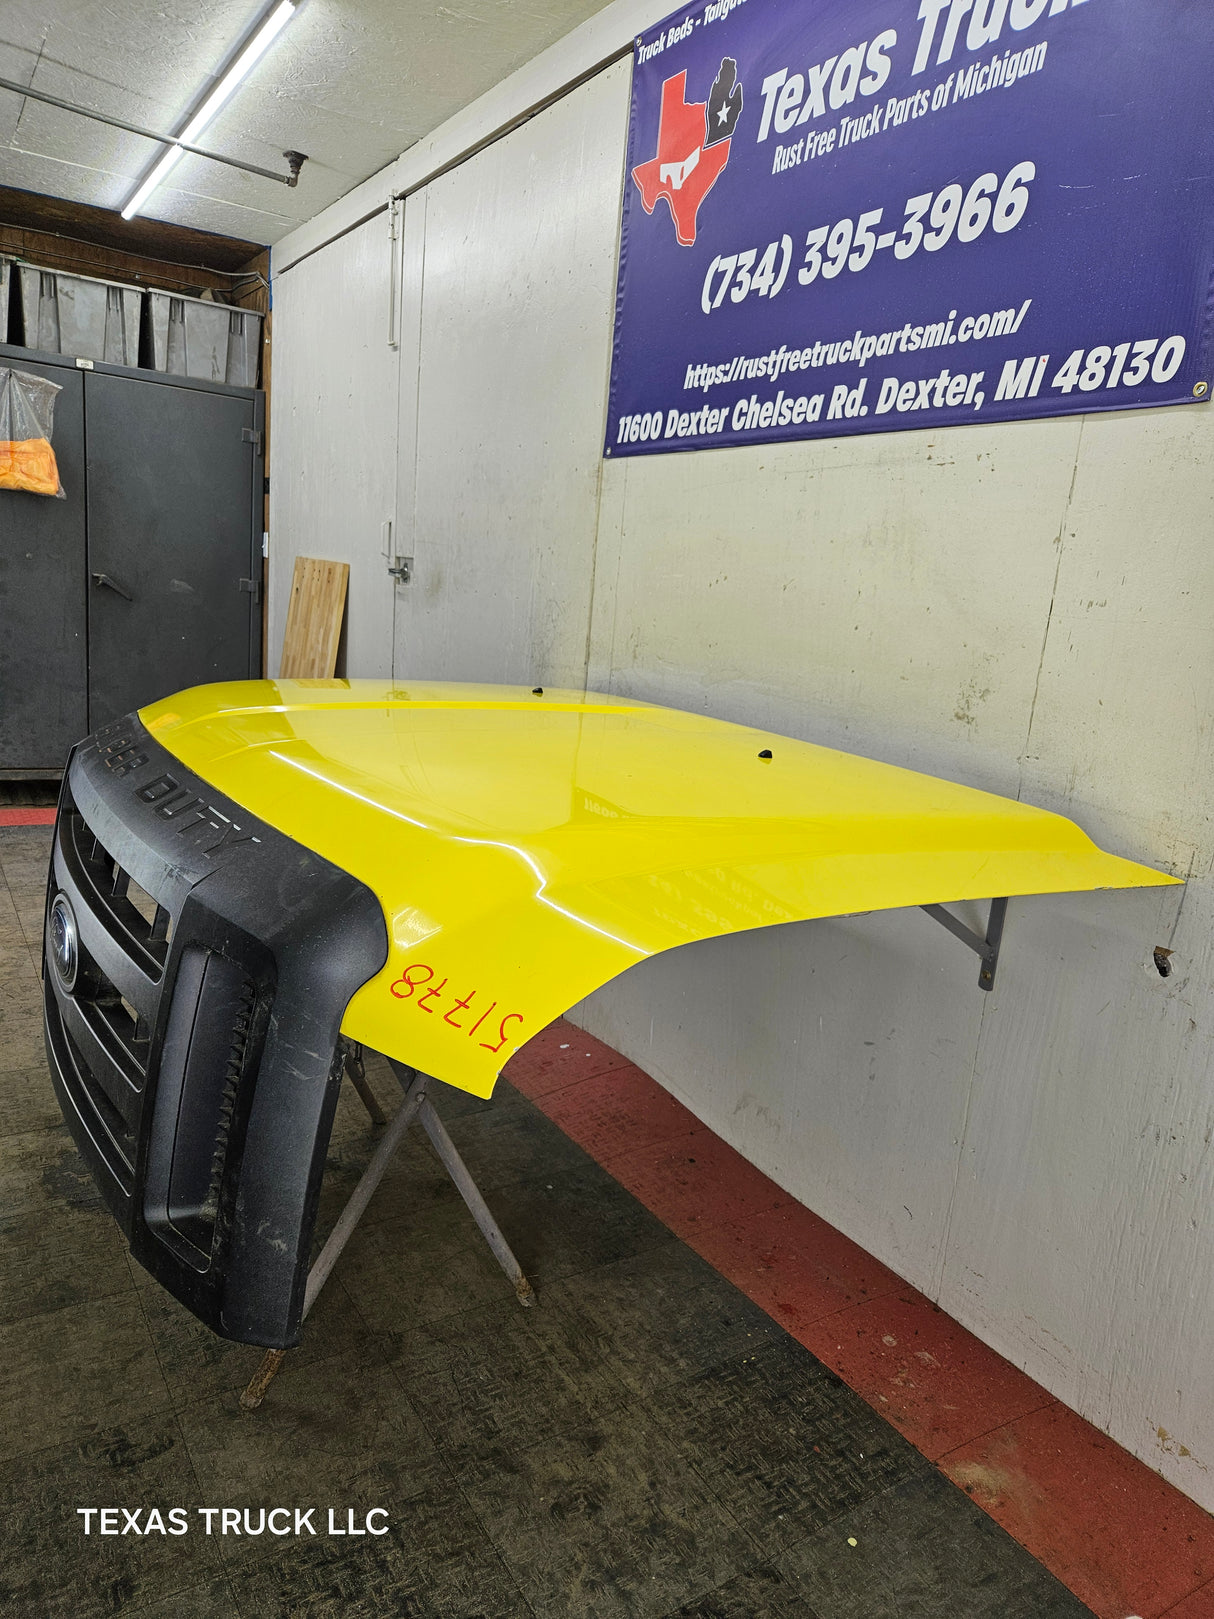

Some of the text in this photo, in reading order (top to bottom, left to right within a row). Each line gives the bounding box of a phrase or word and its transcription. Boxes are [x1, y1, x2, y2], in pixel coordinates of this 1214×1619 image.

[637, 0, 748, 65] Truck Beds - Tailga
[757, 0, 1090, 144] Texas Tru
[771, 40, 1048, 175] Rust Free Truck Parts of Michigan
[701, 160, 1036, 315] (734) 395-3966
[616, 335, 1187, 444] 11600 Dexter Chelsea Rd. Dexter, MI 48130
[683, 299, 1033, 392] https://rustfreetruckpartsmi.com/
[132, 772, 262, 860] DUTY
[389, 964, 524, 1053] 51778
